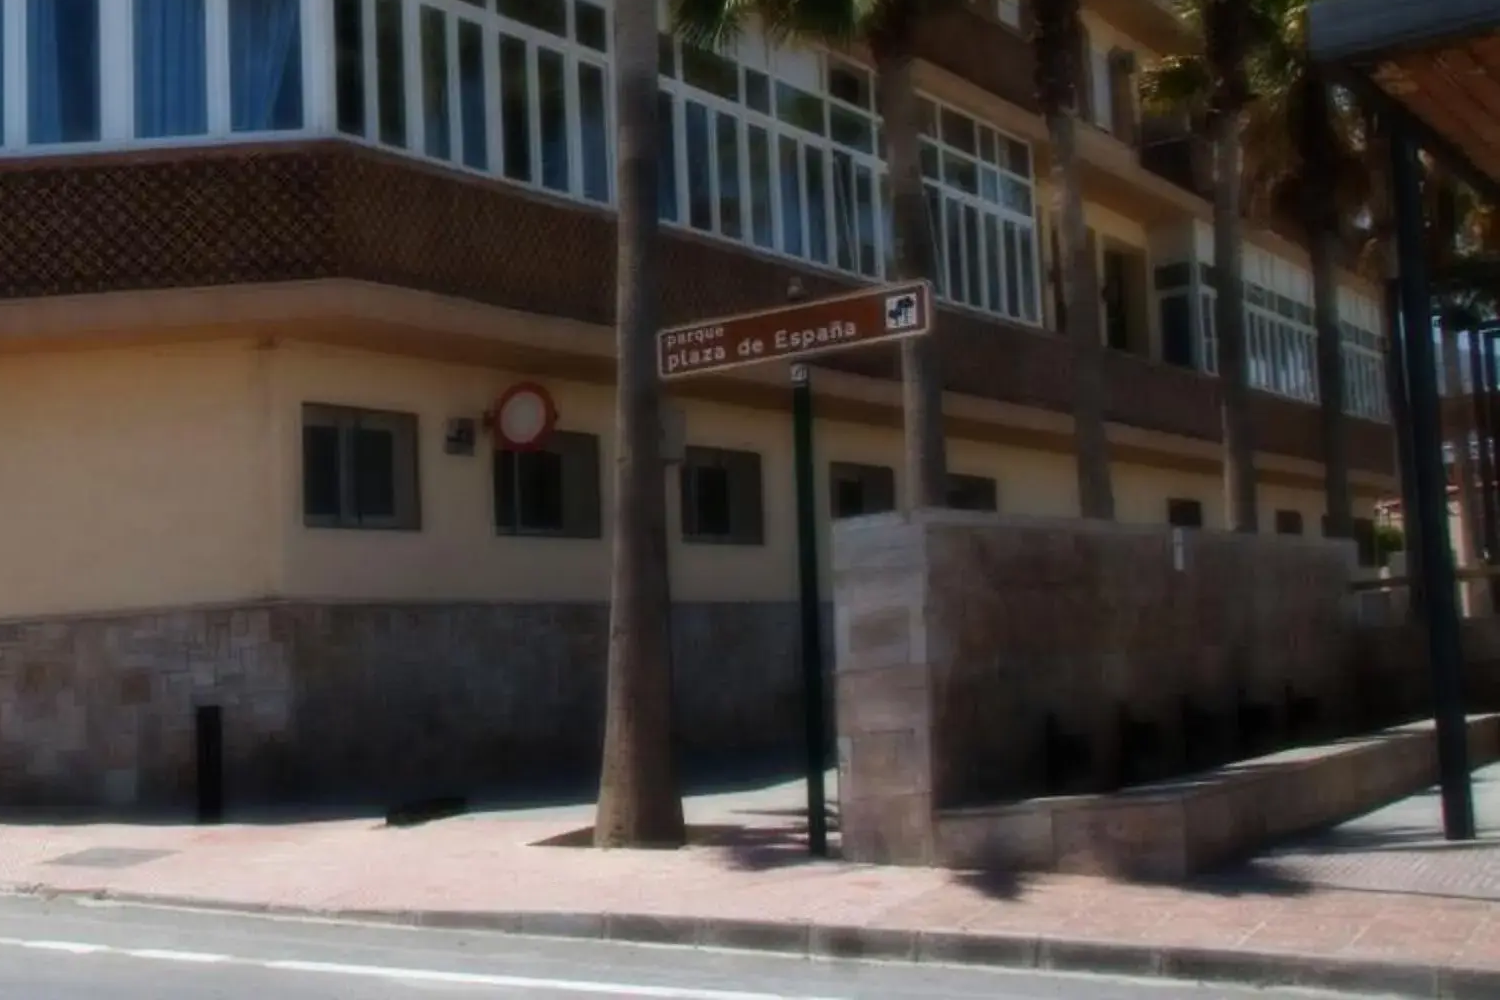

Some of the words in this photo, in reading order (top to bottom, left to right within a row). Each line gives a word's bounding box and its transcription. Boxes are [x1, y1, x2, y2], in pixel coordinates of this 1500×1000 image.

[666, 326, 724, 347] parque
[667, 345, 725, 371] plaza
[737, 337, 764, 357] de
[774, 320, 857, 349] España
